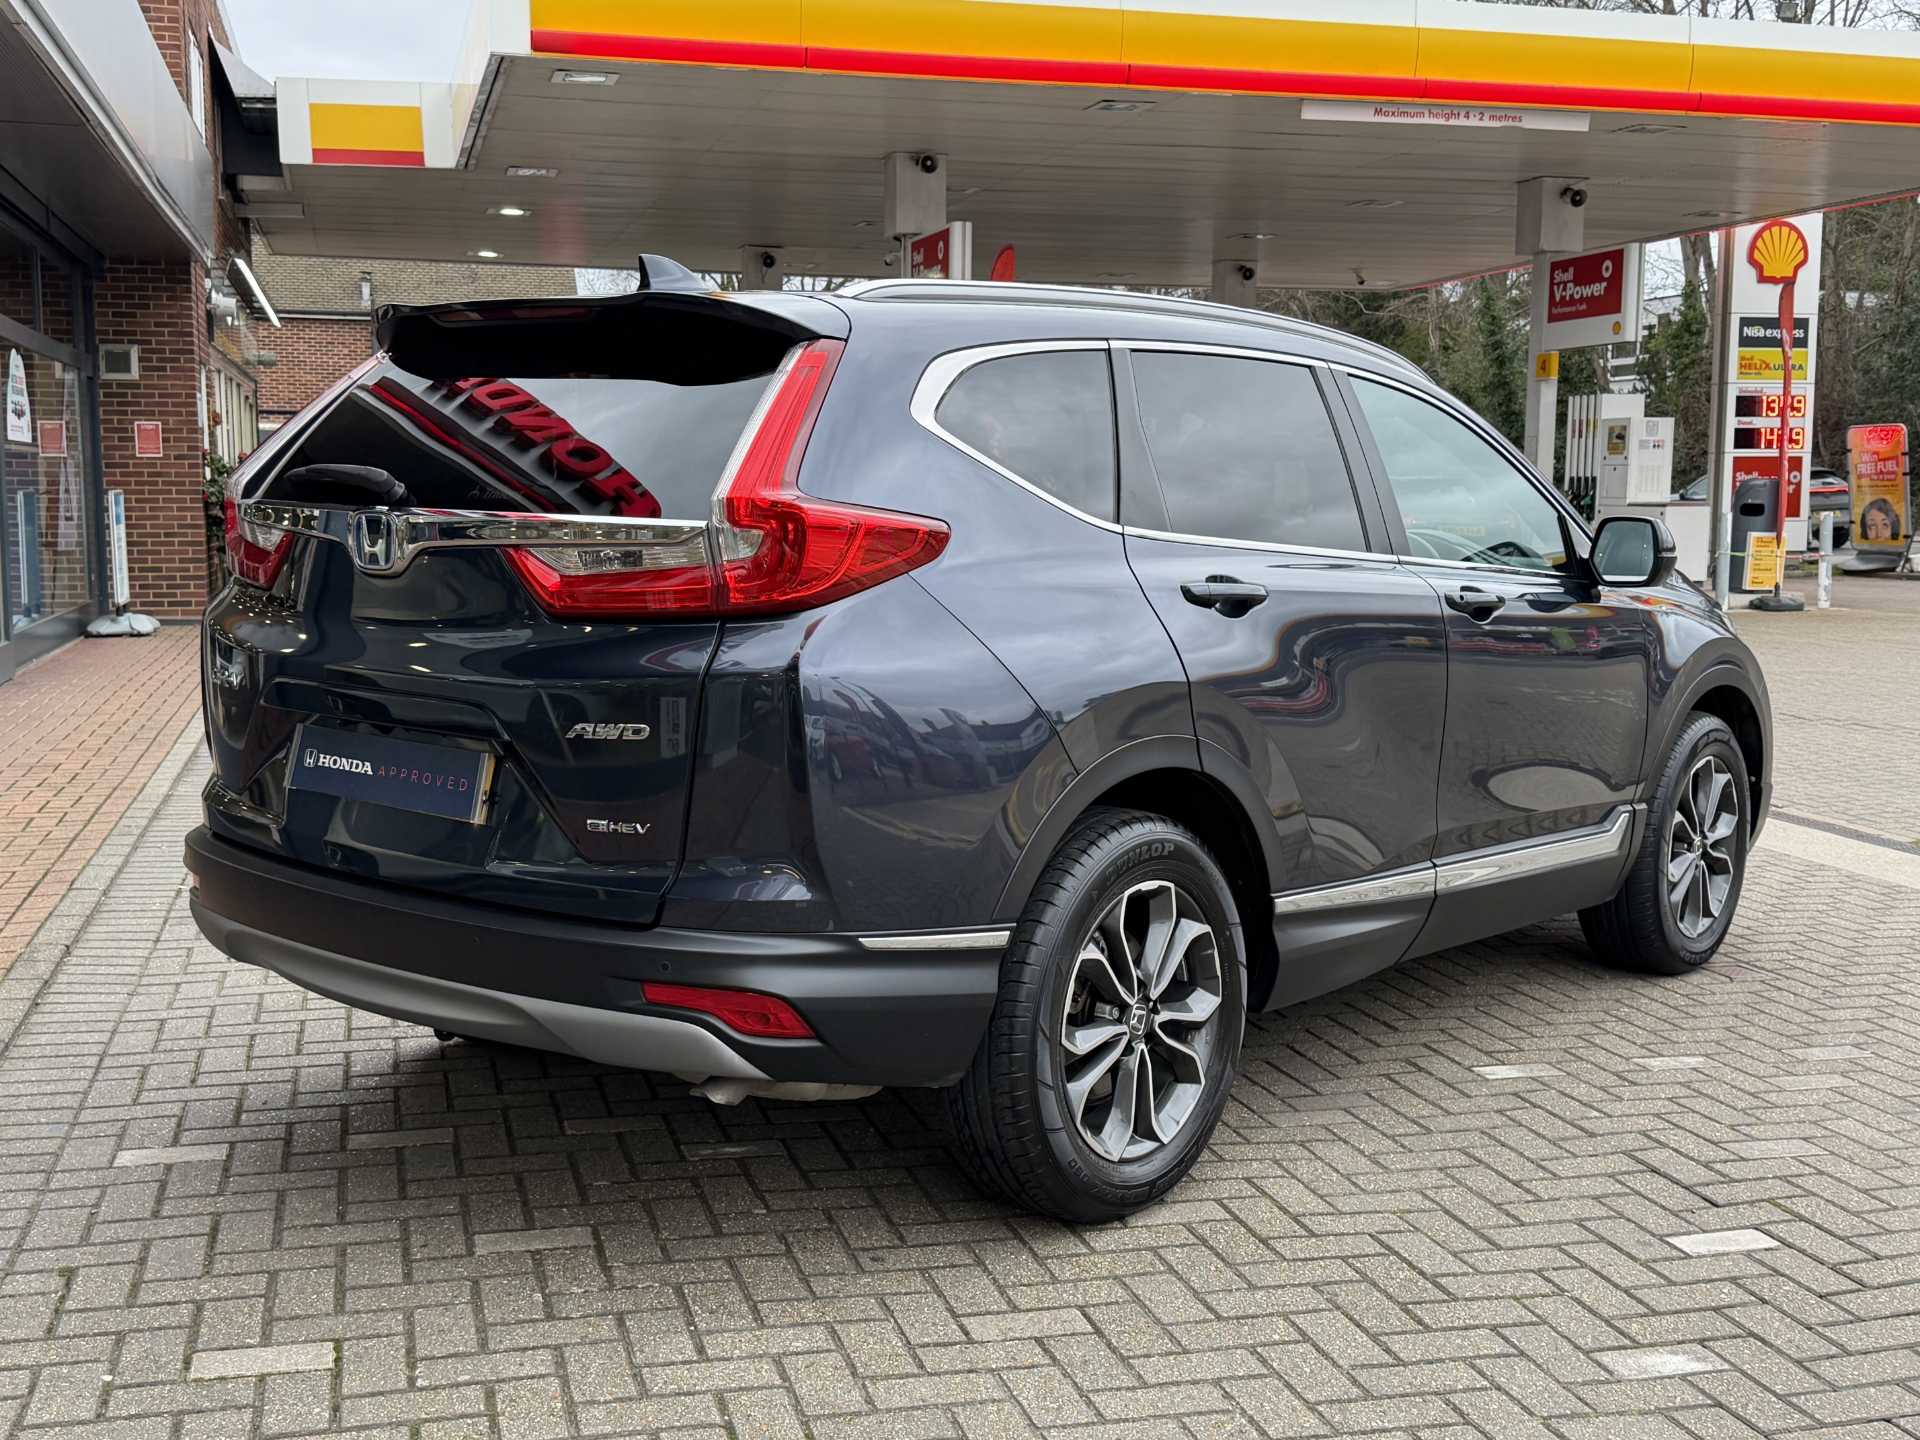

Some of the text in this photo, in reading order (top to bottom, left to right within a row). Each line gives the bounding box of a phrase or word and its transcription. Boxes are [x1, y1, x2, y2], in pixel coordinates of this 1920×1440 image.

[1373, 107, 1425, 119] Maximum
[1428, 109, 1460, 122] height
[1488, 113, 1523, 122] metres
[1553, 267, 1574, 283] Shell
[1553, 281, 1607, 302] V-Power
[1743, 326, 1765, 337] Nisa
[1739, 360, 1771, 371] HELIX
[1877, 460, 1898, 473] FUEL
[564, 722, 651, 740] AWD
[317, 753, 470, 792] HONDA APPROVED
